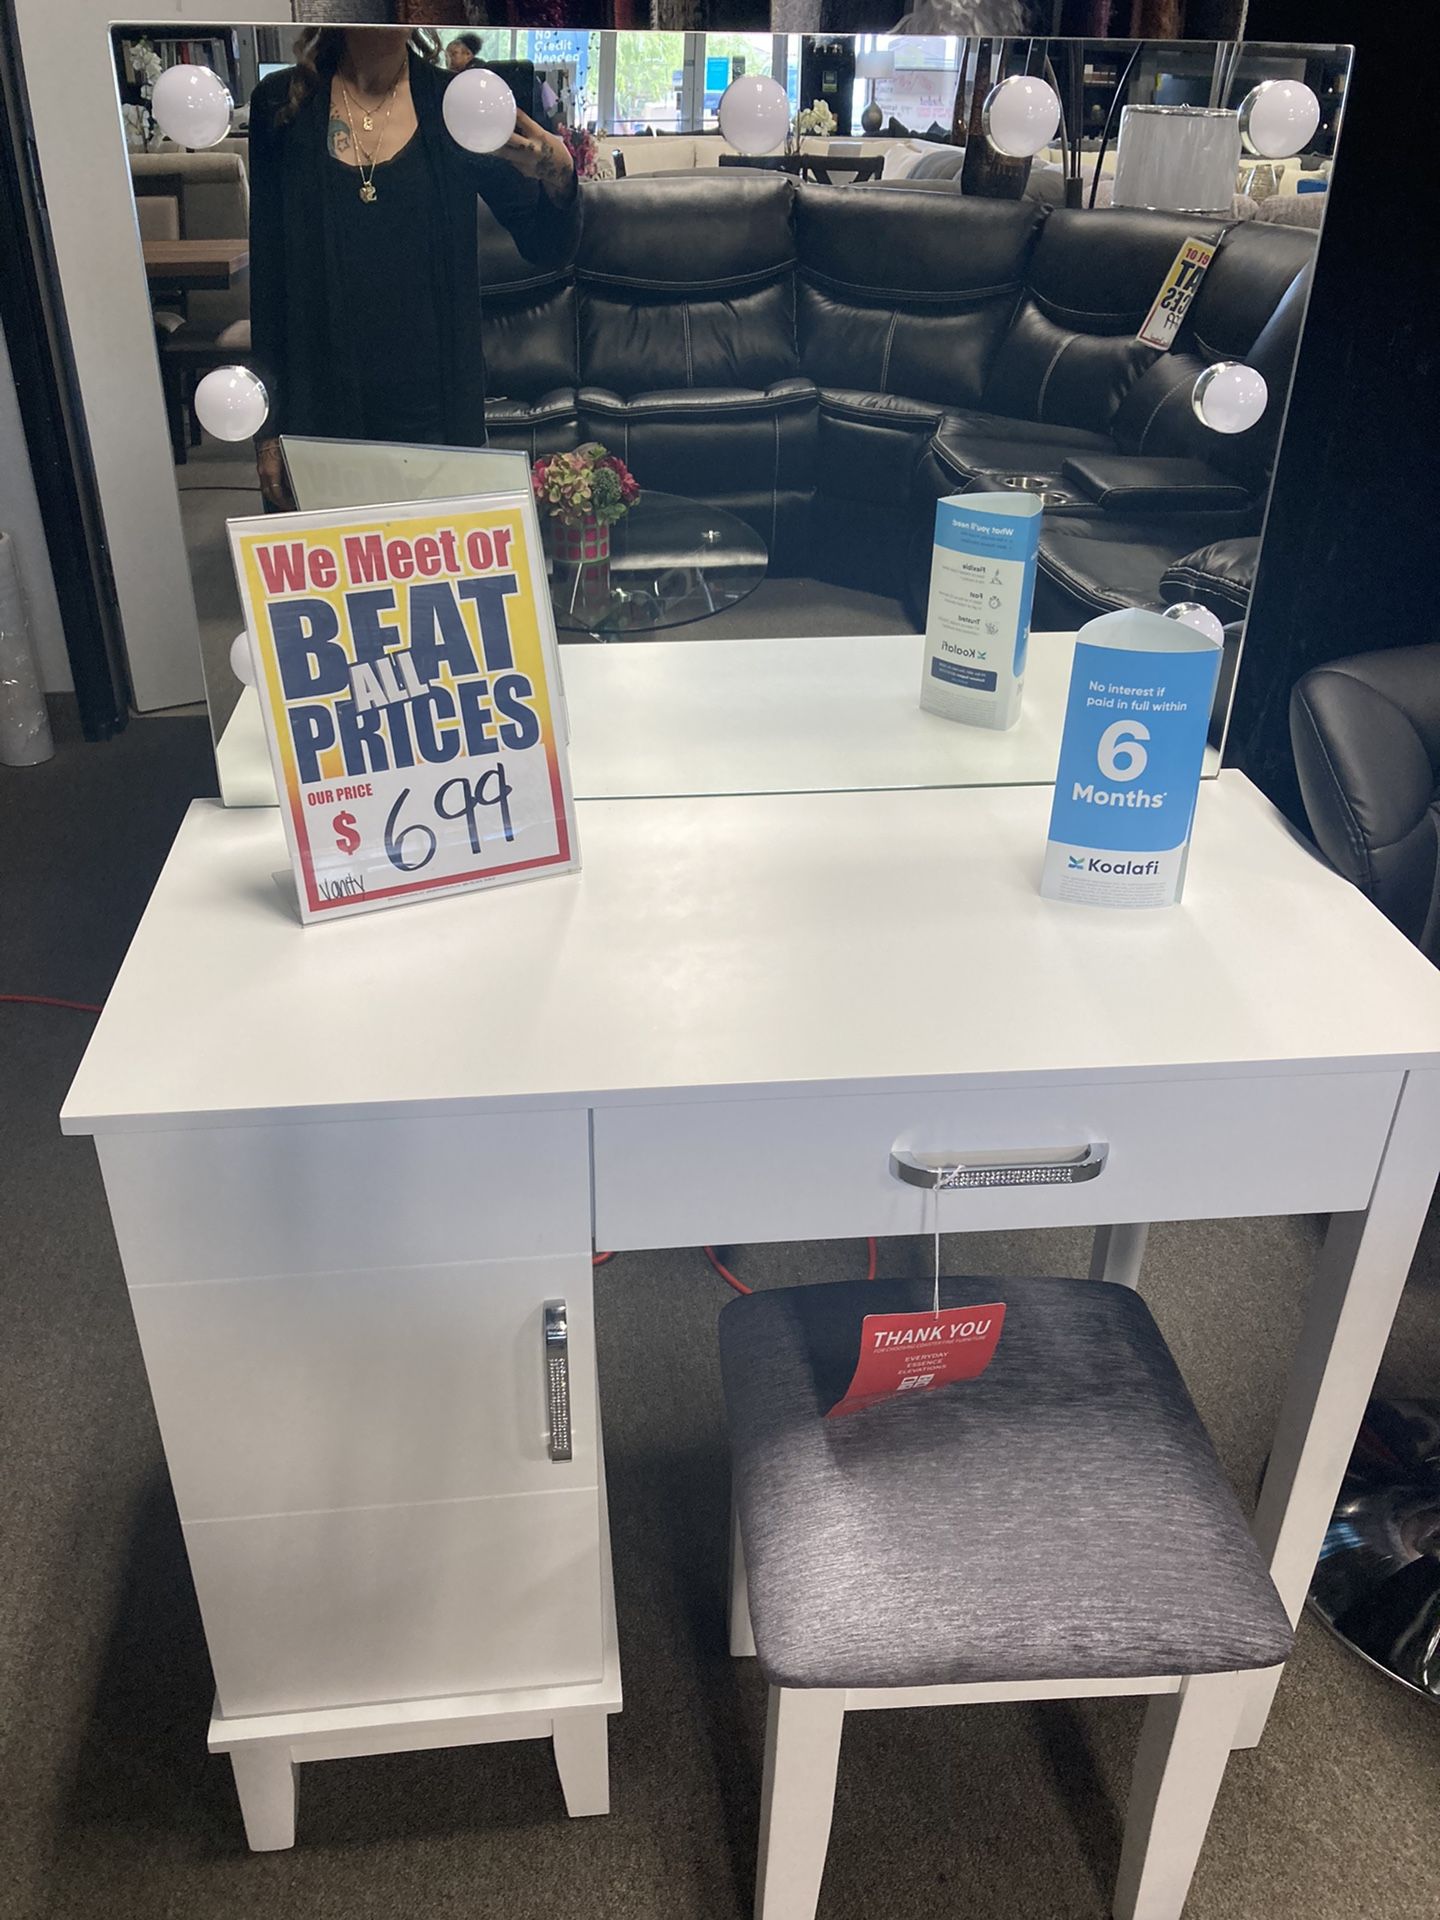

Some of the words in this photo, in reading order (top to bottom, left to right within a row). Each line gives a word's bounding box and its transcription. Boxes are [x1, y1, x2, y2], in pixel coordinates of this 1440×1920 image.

[534, 39, 573, 52] Credit
[535, 30, 551, 40] No
[256, 542, 338, 594] We
[344, 530, 460, 585] Meet
[467, 527, 511, 571] or
[267, 574, 518, 700] BEAT
[350, 651, 430, 713] ALL
[1089, 680, 1106, 692] No
[1108, 683, 1154, 697] interest
[1156, 687, 1167, 697] if
[1086, 697, 1115, 708] paid
[1117, 699, 1128, 709] in
[1131, 700, 1150, 711] full
[1152, 701, 1187, 712] within
[288, 674, 540, 784] PRICES
[1097, 719, 1150, 782] 6
[308, 789, 335, 807] OUR
[336, 783, 373, 802] PRICE
[332, 810, 361, 856] $
[1088, 857, 1160, 875] Koalafi
[874, 1325, 946, 1348] THANK
[950, 1319, 992, 1338] YOU
[905, 1351, 949, 1362] EVERYDAY
[907, 1359, 942, 1369] ESSENCE
[897, 1364, 947, 1375] ELEVATIONS
